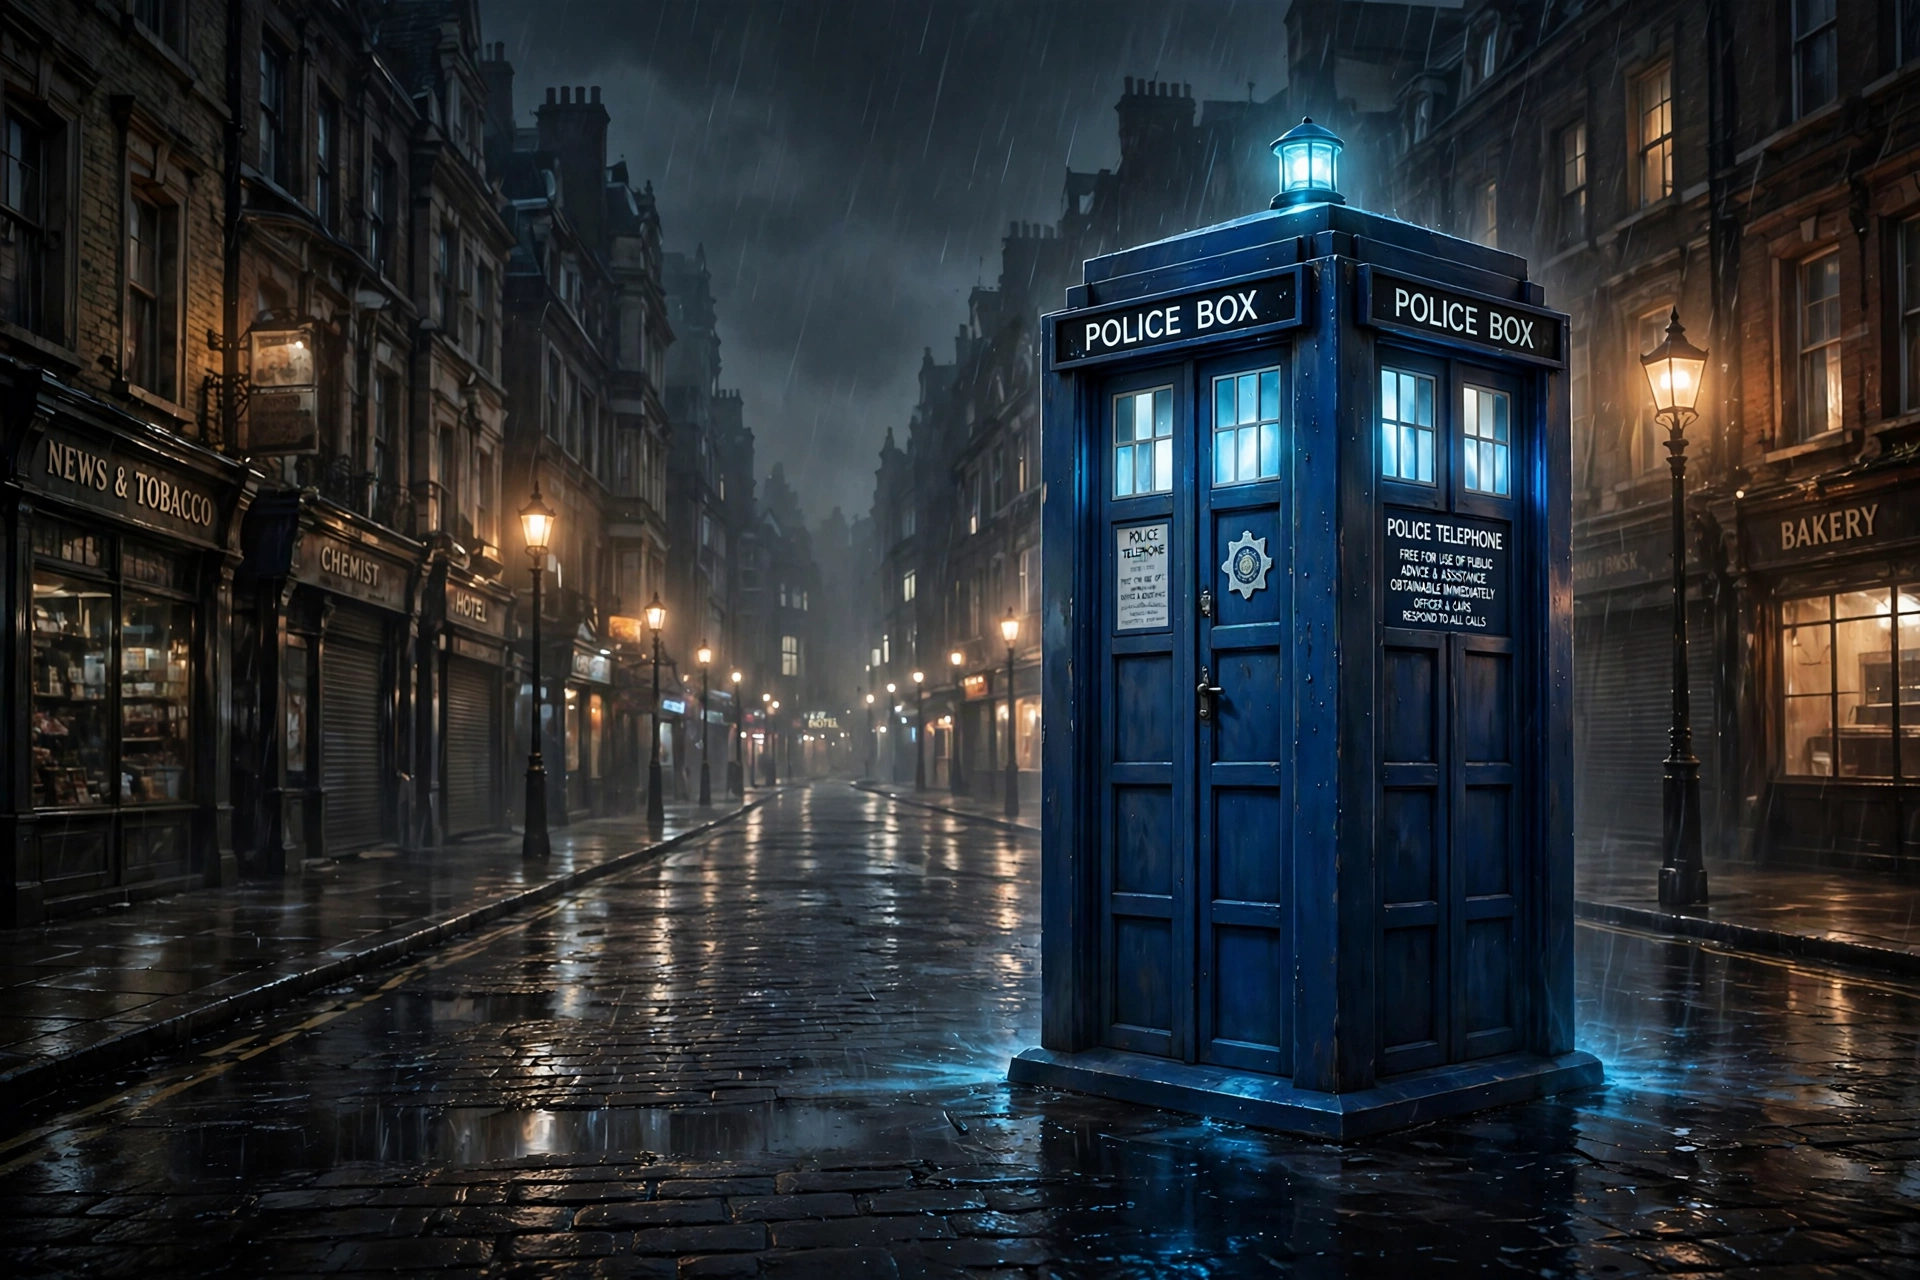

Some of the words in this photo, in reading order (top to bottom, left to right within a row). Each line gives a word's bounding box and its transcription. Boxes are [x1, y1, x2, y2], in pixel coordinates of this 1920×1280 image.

[1085, 305, 1182, 352] POLICE
[1197, 289, 1258, 330] BOX
[1395, 287, 1478, 336] POLICE
[1489, 311, 1535, 349] BOX
[47, 439, 108, 491] NEWS
[115, 466, 128, 499] &
[135, 470, 212, 527] TOBACCO
[1387, 517, 1432, 540] POLICE
[1435, 523, 1503, 550] TELEPHONE
[1781, 503, 1879, 551] BAKERY
[321, 546, 380, 587] CHEMIST
[1399, 548, 1419, 561] FREE
[1421, 551, 1437, 563] FOR
[456, 591, 487, 623] HOTEL
[1438, 612, 1449, 623] TO
[1449, 614, 1464, 625] ALL
[1465, 615, 1487, 626] CALLS
